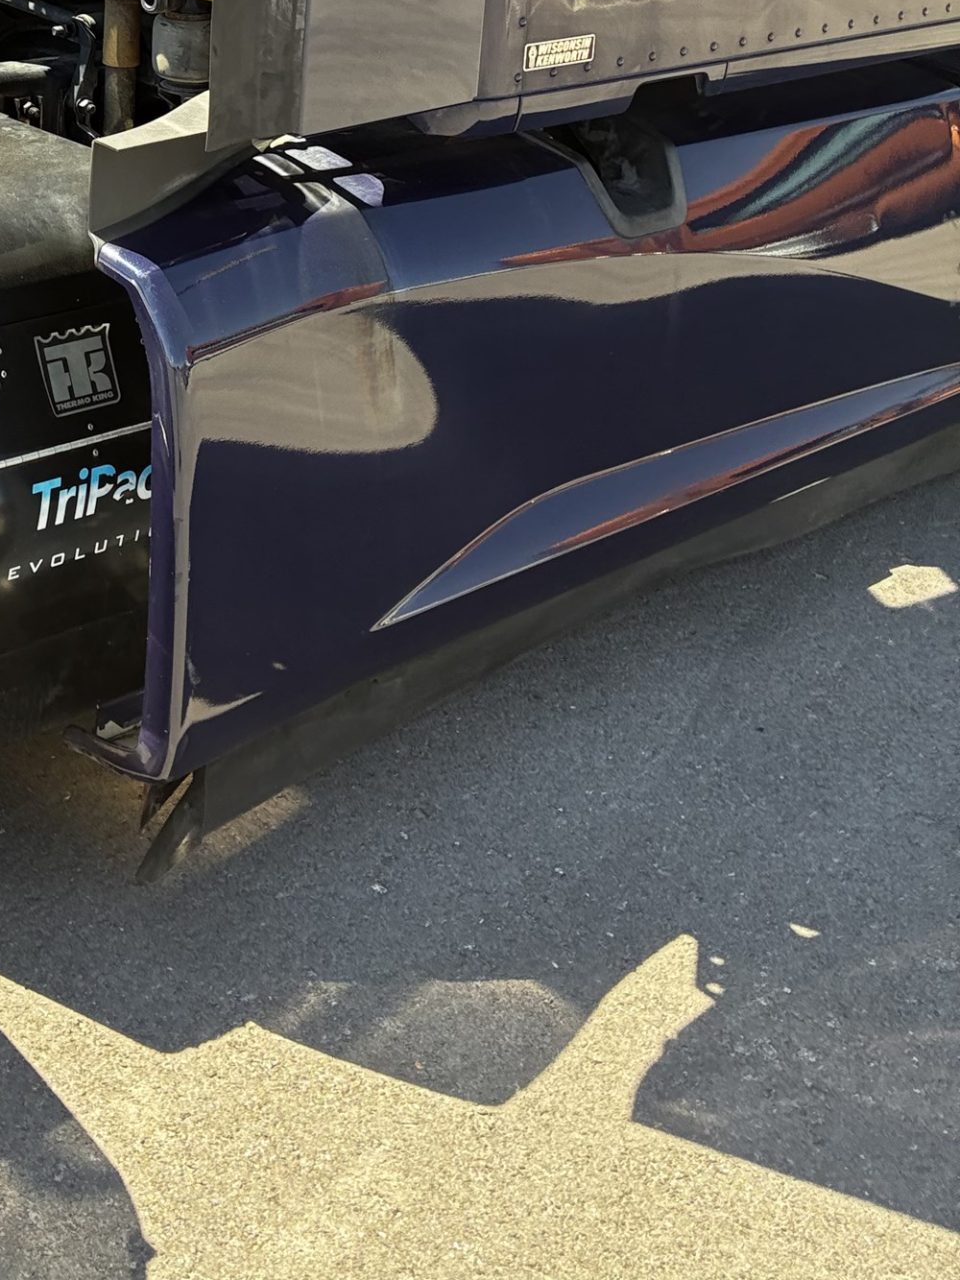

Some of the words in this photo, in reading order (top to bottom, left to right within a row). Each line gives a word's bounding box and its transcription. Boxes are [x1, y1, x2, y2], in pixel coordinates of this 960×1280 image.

[537, 37, 593, 56] WISCONSIN
[535, 48, 590, 67] KENWORTH
[55, 397, 92, 411] THERMO
[92, 391, 114, 403] KING
[7, 527, 152, 581] EVOLUTI
